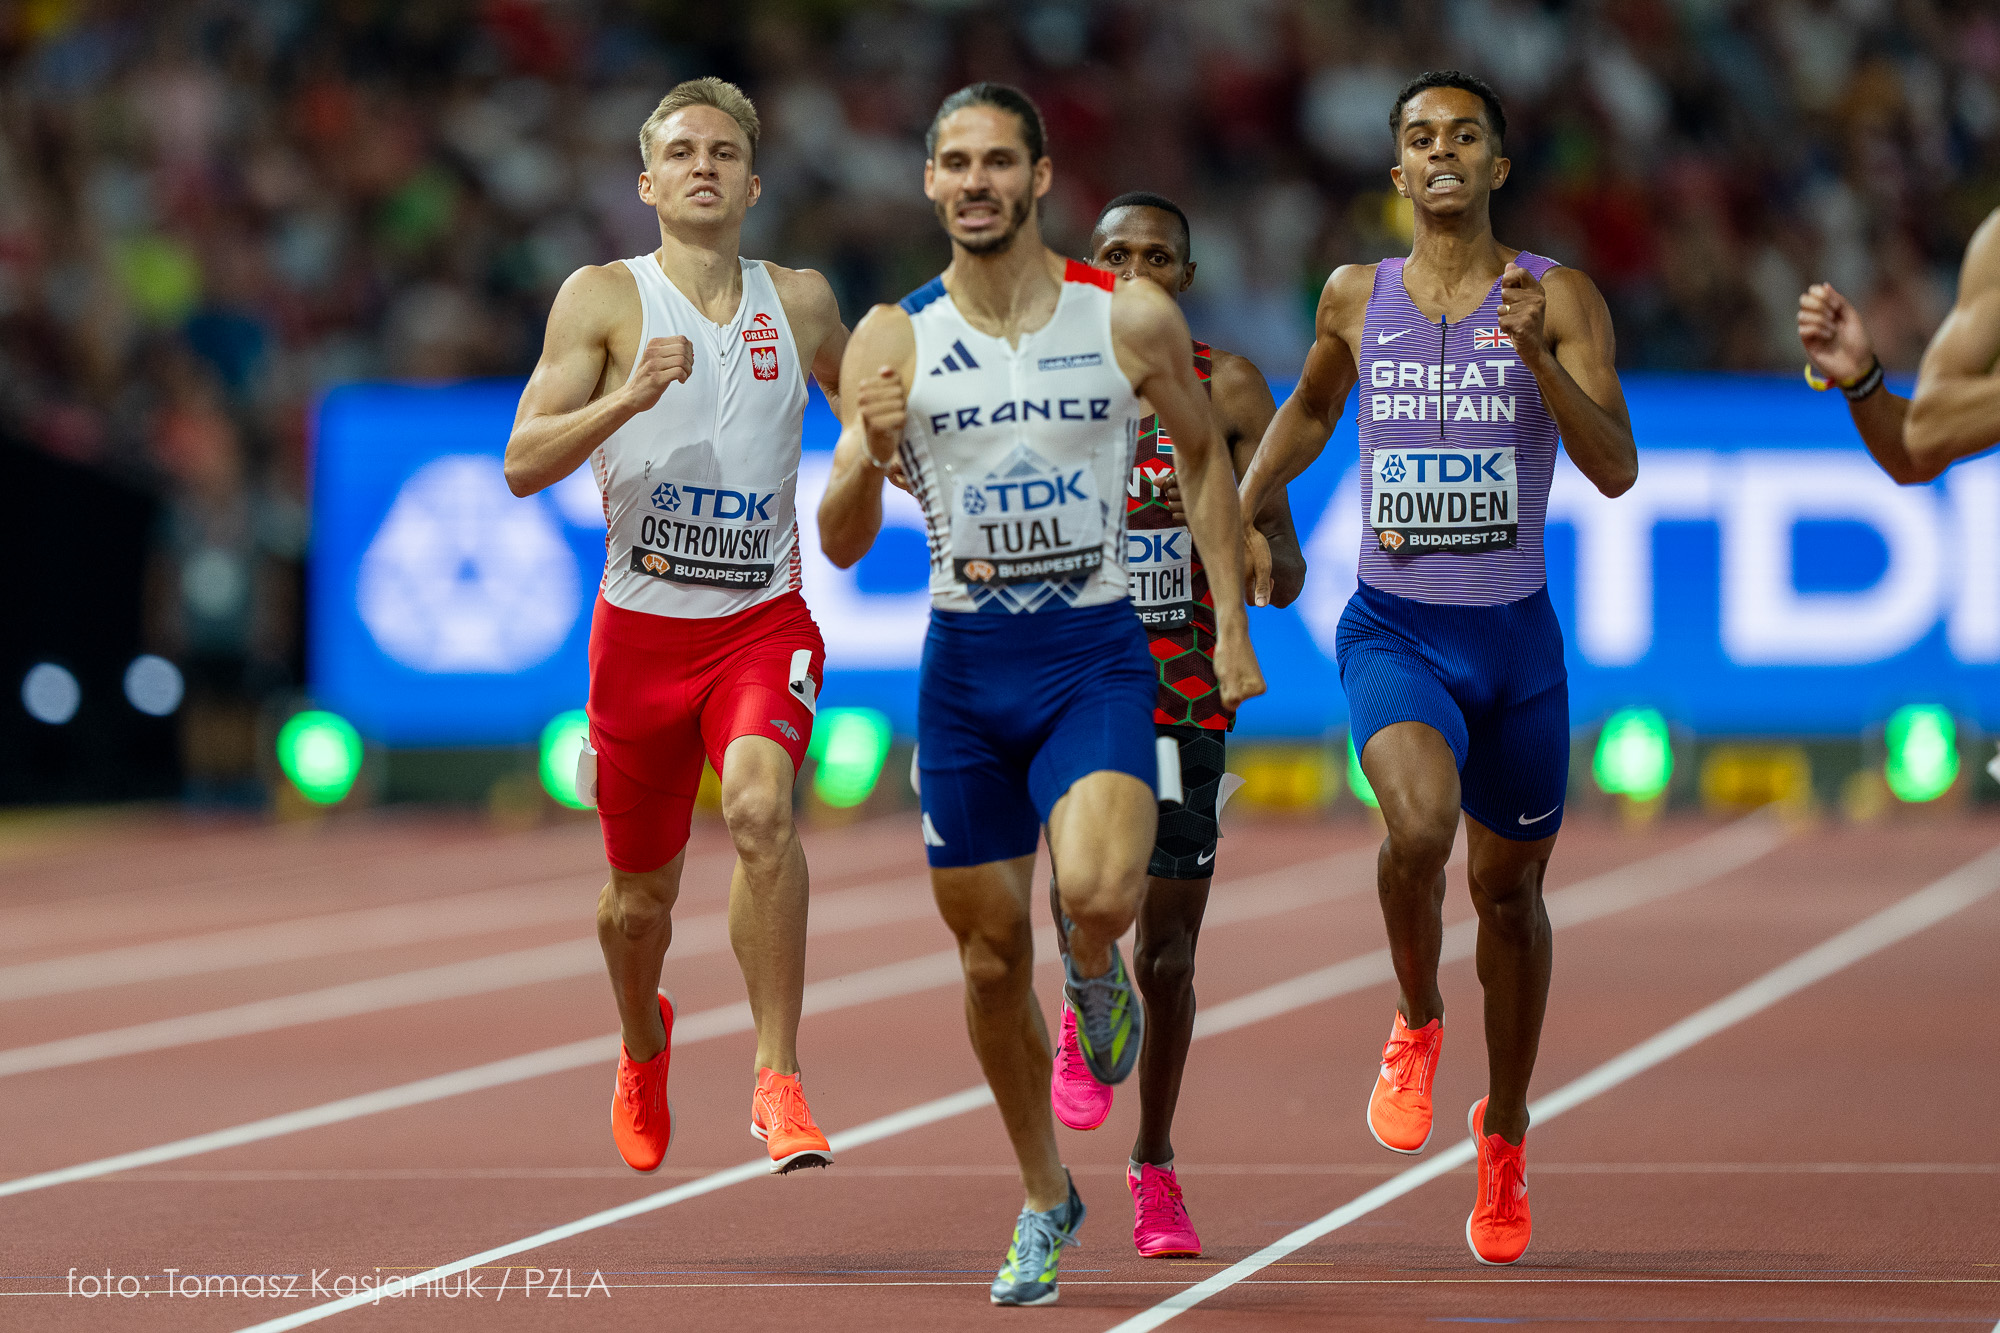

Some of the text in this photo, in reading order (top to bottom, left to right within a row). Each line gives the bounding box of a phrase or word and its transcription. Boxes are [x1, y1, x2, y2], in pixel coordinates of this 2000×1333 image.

[744, 330, 777, 342] ORLEN
[1371, 360, 1515, 390] GREAT
[930, 398, 1111, 435] FRANCE
[1372, 394, 1516, 422] BRITAIN
[1406, 452, 1506, 483] TDK
[682, 487, 776, 521] TDK
[985, 469, 1089, 512] TDK
[1378, 491, 1507, 523] ROWDEN
[640, 515, 770, 559] OSTROWSKI
[979, 517, 1072, 554] TUAL
[1128, 531, 1183, 563] DK
[1409, 531, 1508, 546] BUDAPEST 23
[674, 564, 767, 582] BUDAPEST 23
[997, 554, 1082, 578] BUDAPEST
[1128, 567, 1185, 602] ETICH
[1170, 609, 1186, 620] 23
